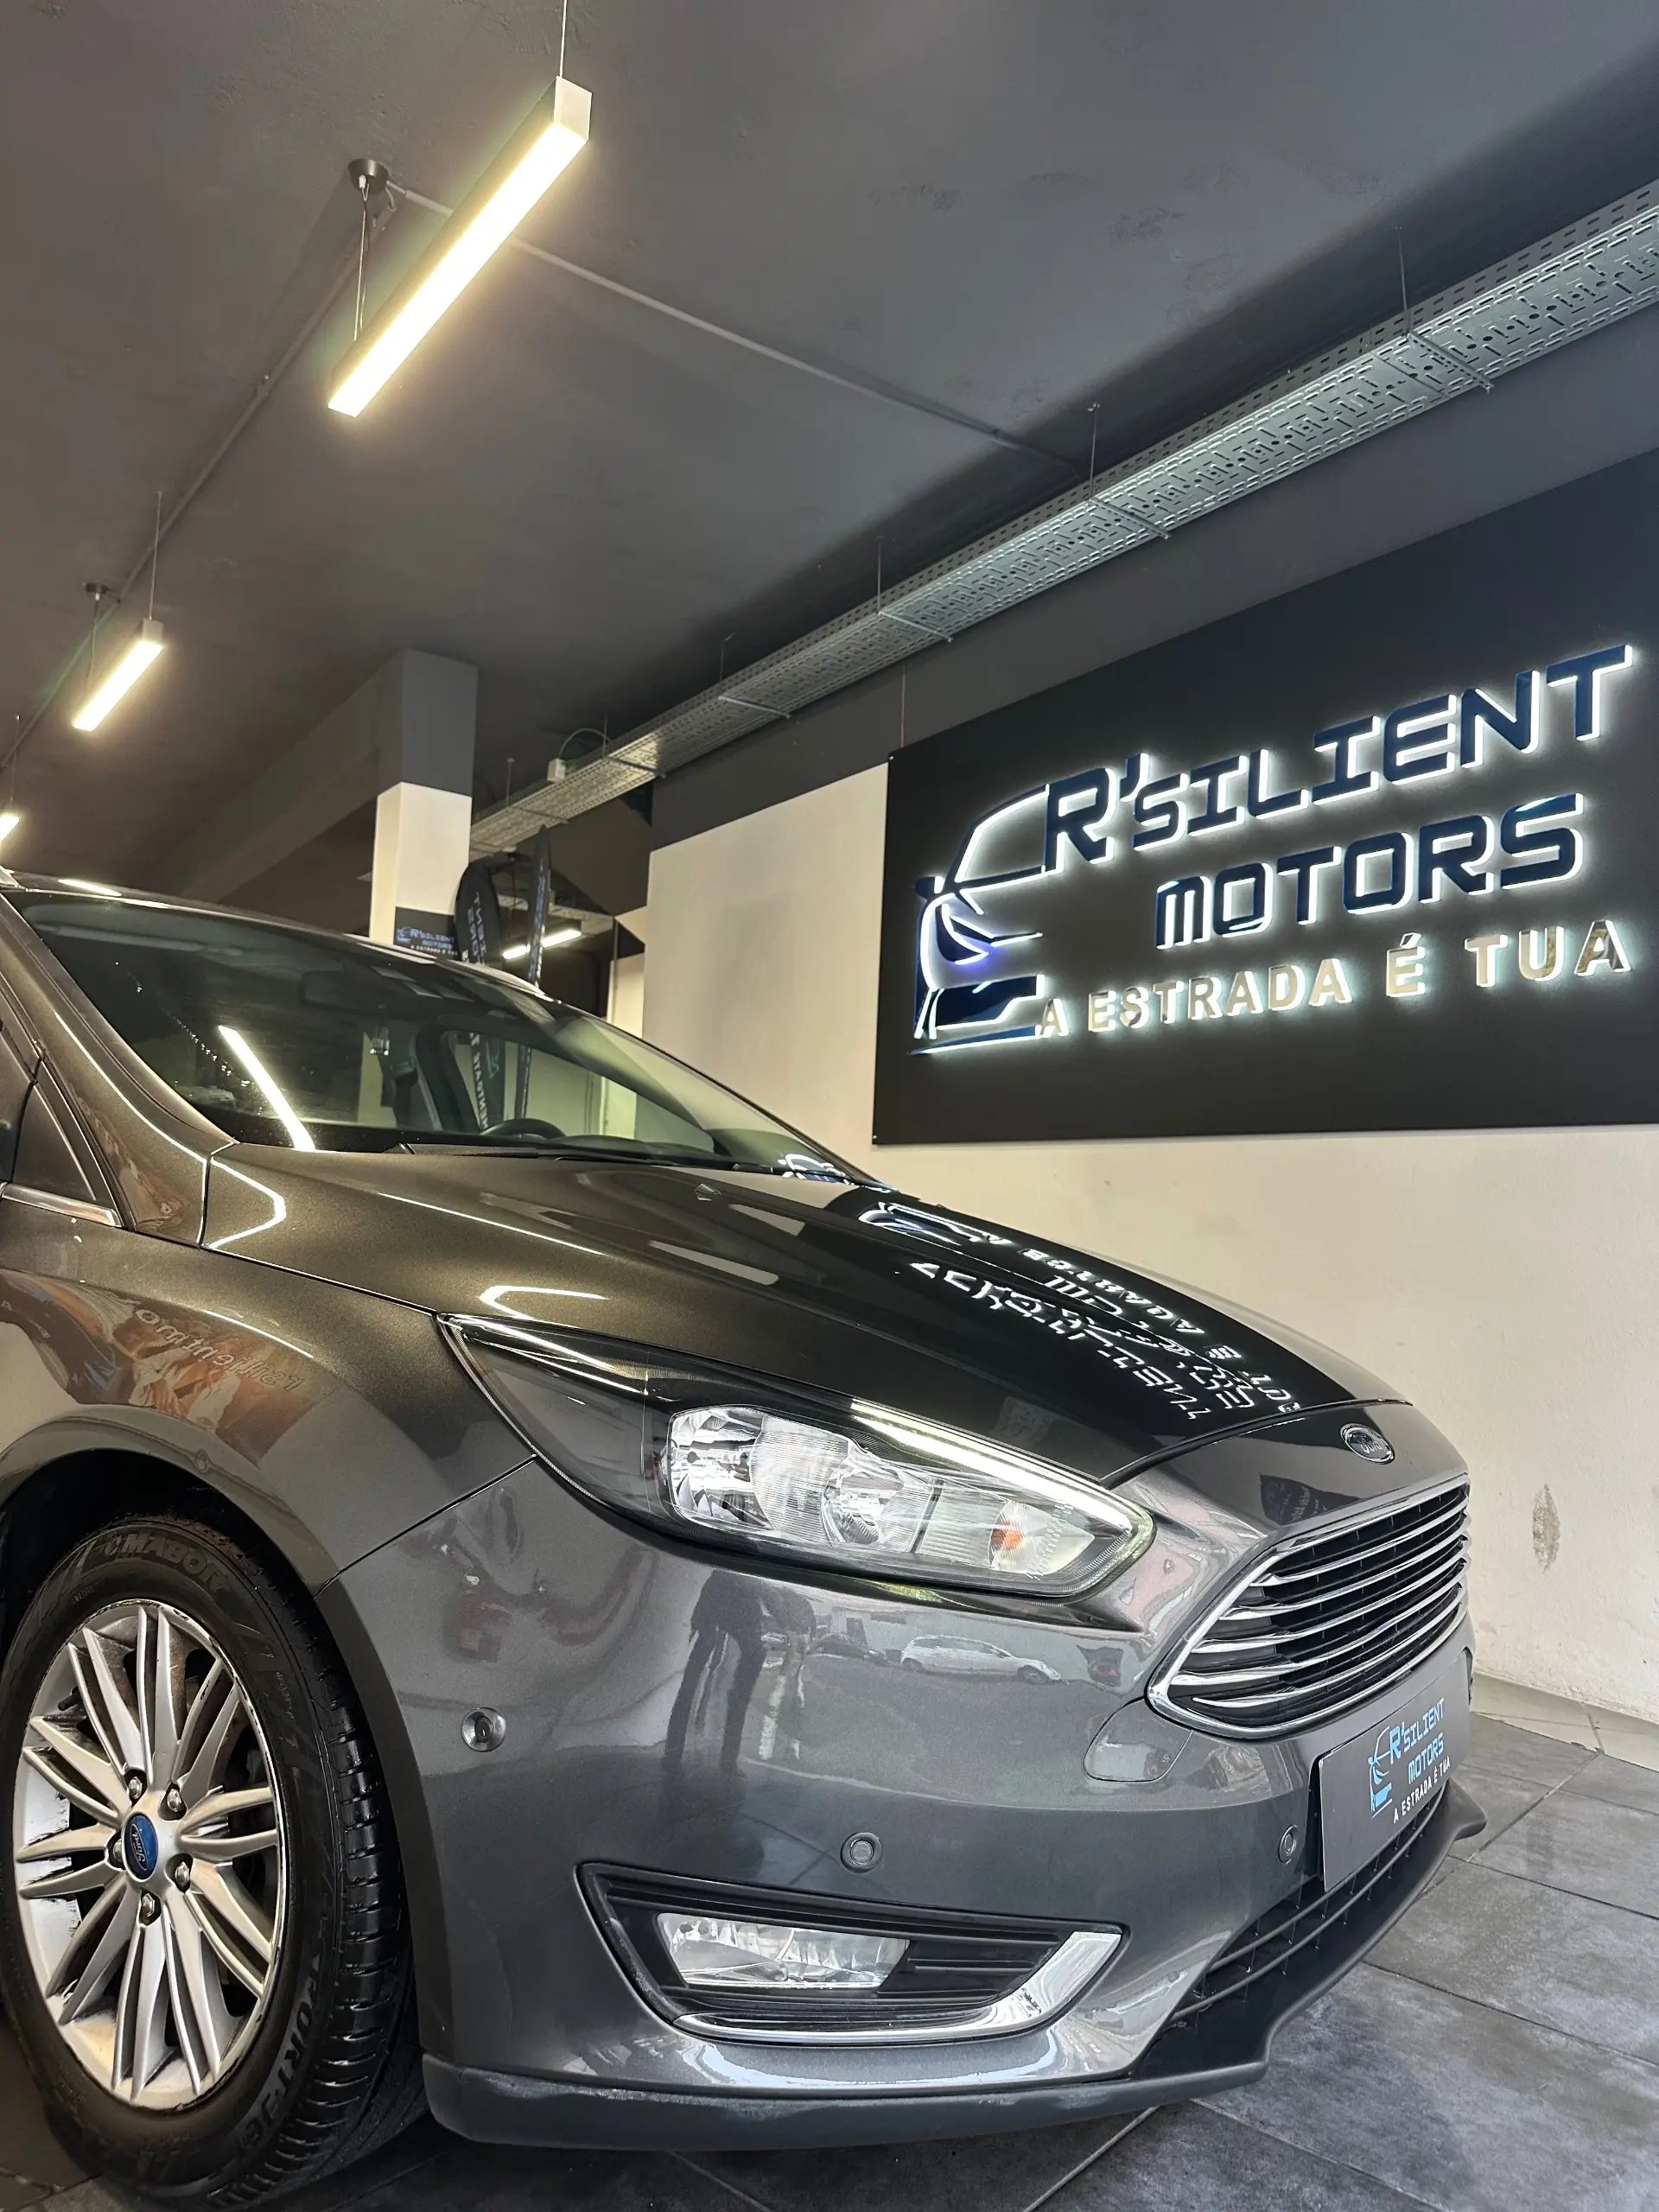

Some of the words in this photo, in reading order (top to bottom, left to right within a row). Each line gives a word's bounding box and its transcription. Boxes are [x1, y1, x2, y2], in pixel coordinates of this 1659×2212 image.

[1043, 644, 1633, 873] R'SILIENT
[1155, 792, 1584, 950] MOTORS
[1036, 1001, 1069, 1037] A
[1088, 957, 1351, 1033] ESTRADA
[1386, 934, 1425, 995] É
[1465, 919, 1633, 987] TUA
[1389, 1697, 1444, 1764] R'SILIENT
[1408, 1732, 1444, 1784] MOTORS
[1394, 1807, 1399, 1823] A
[1402, 1776, 1432, 1815] ESTRADA
[1433, 1766, 1438, 1783] É
[1440, 1756, 1451, 1777] TUA
